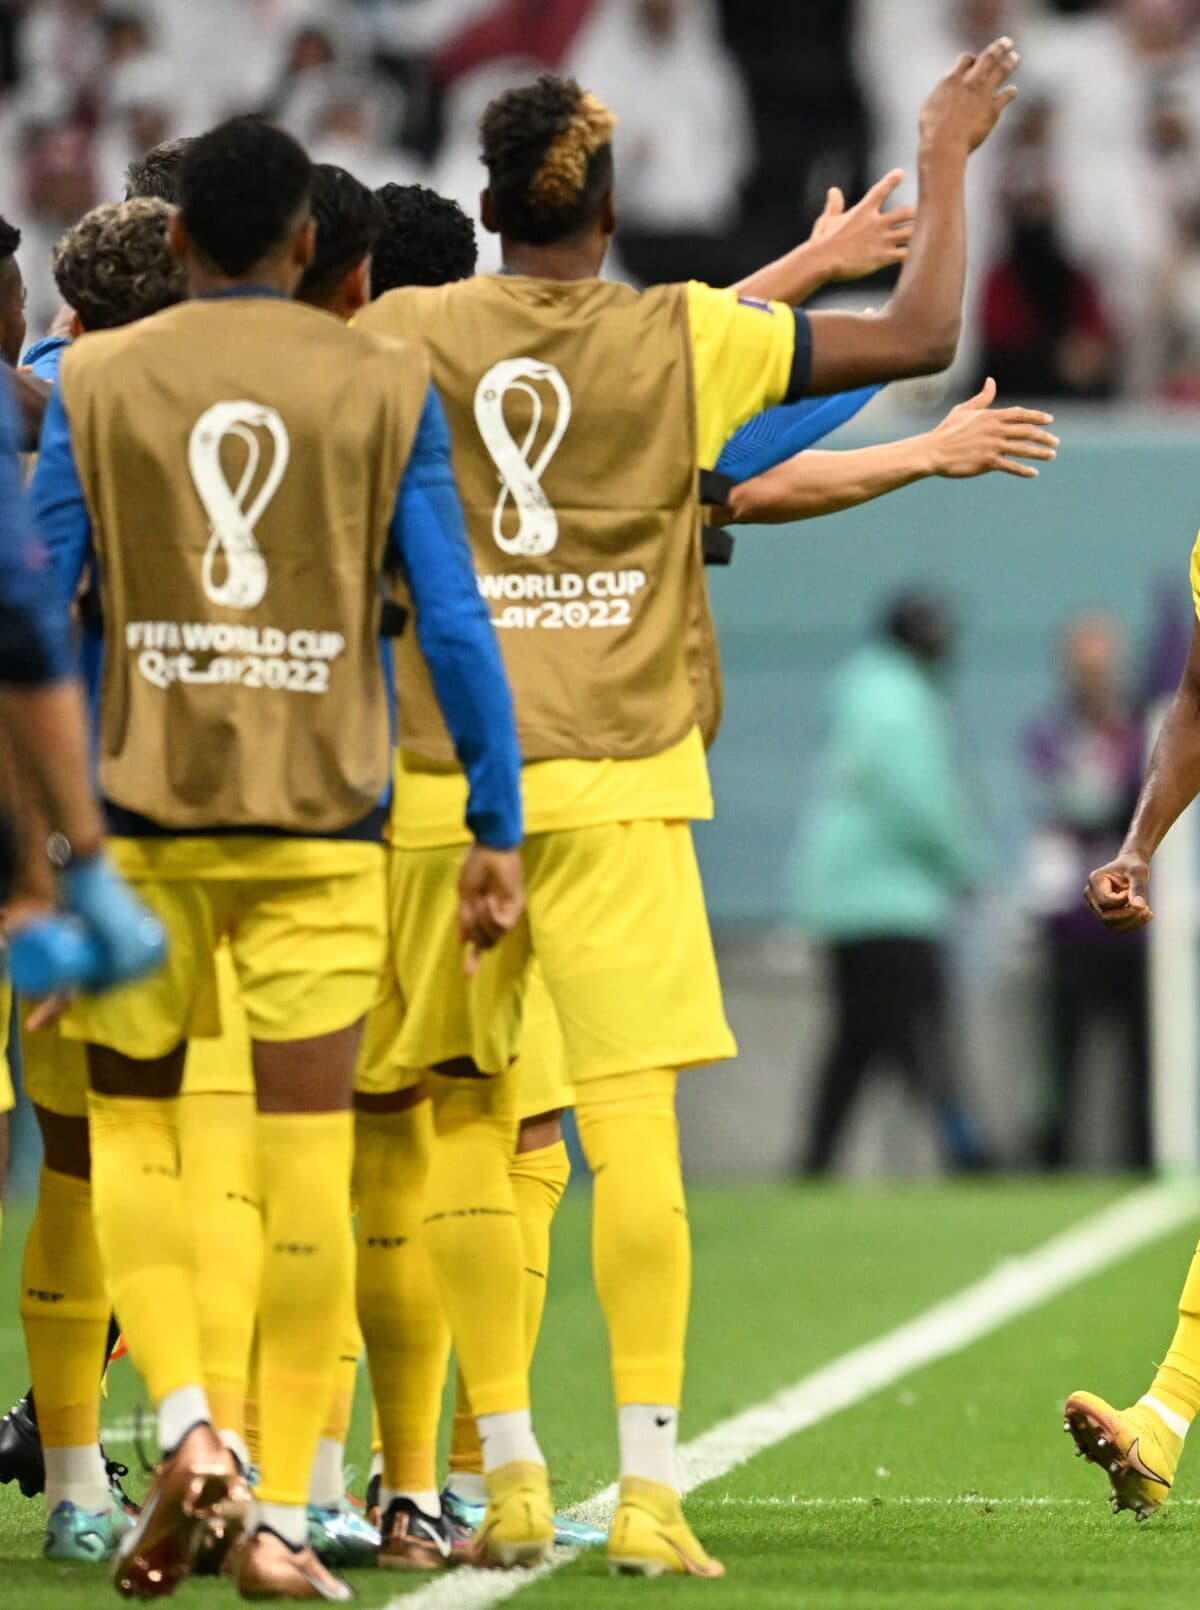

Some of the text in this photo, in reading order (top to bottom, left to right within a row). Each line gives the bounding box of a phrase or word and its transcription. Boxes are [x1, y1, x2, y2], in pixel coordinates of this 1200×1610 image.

[476, 569, 646, 600] WORLD CUP
[488, 599, 633, 628] ar2022
[182, 622, 286, 657] WORLD
[287, 629, 345, 660] CUP
